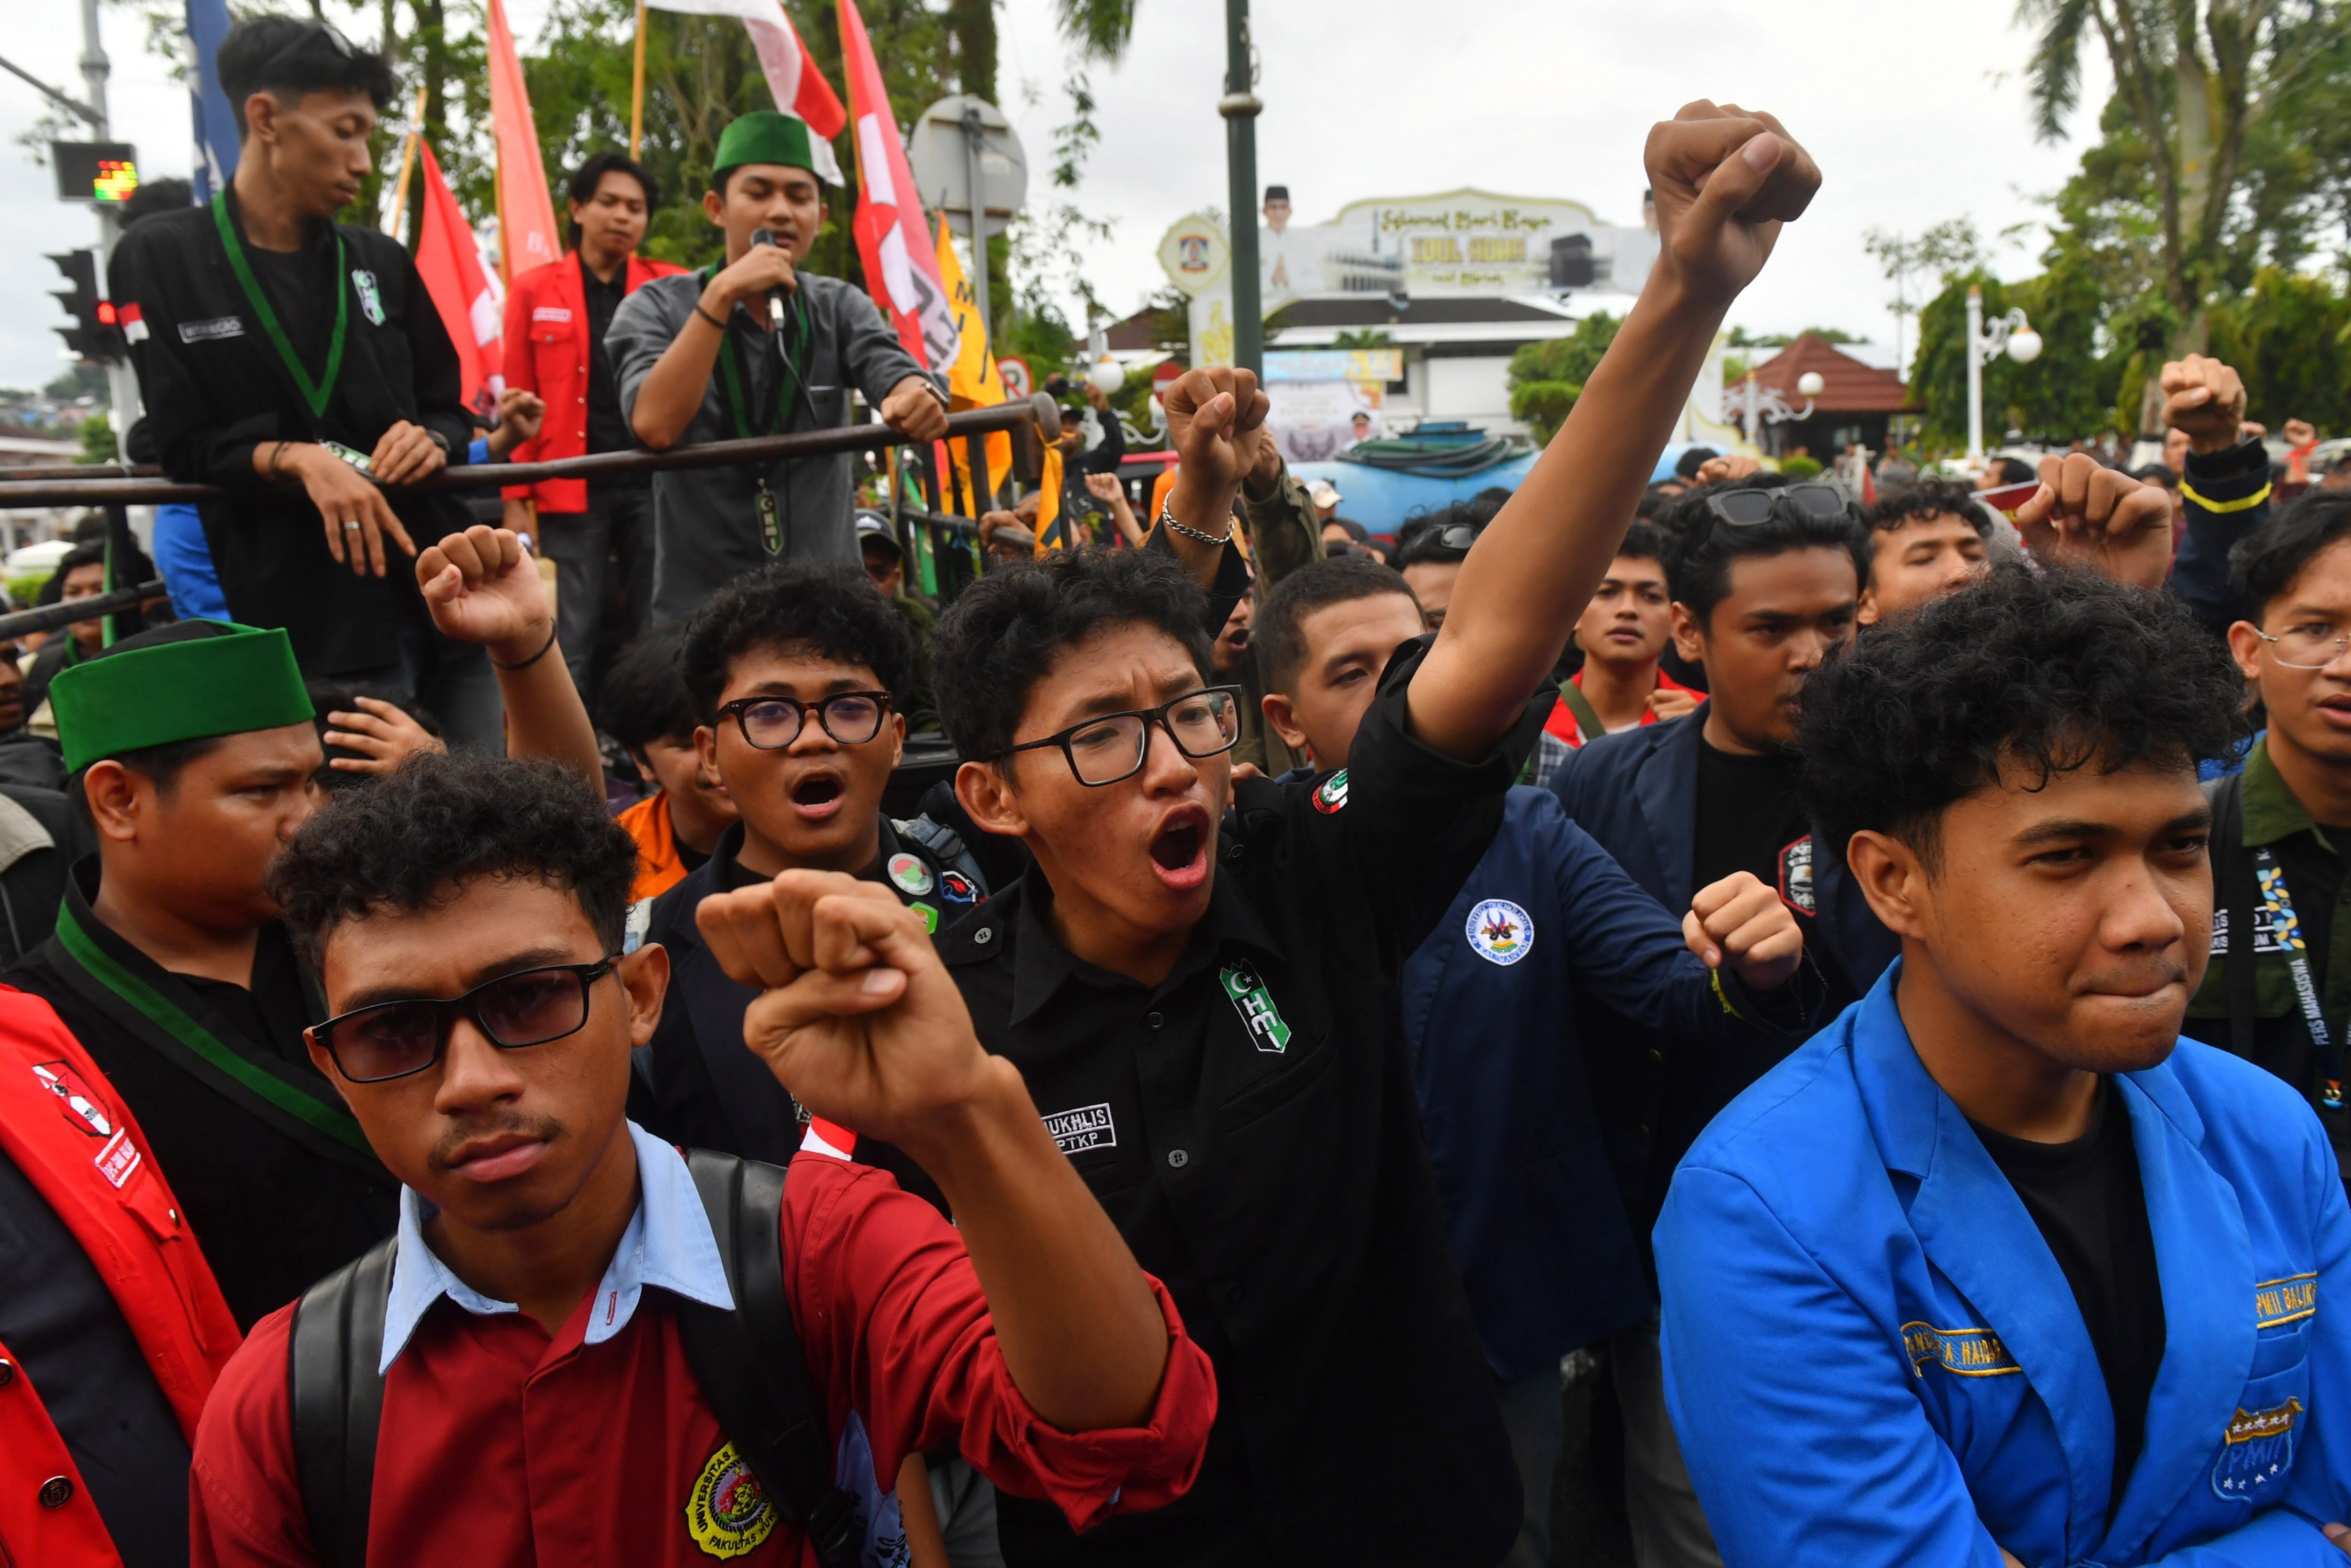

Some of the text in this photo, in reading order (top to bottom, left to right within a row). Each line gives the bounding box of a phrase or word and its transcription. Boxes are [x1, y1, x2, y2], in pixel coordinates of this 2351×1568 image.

[1412, 238, 1526, 263] IDUL ADHA
[1479, 939, 1530, 963] KALIMANTAN
[1242, 993, 1281, 1049] HMI
[2289, 958, 2330, 1046] PERS MAHASISWA
[2228, 1433, 2283, 1473] PMII
[696, 1451, 731, 1533] UNIVERSITAS
[709, 1535, 757, 1551] FAKULTAS
